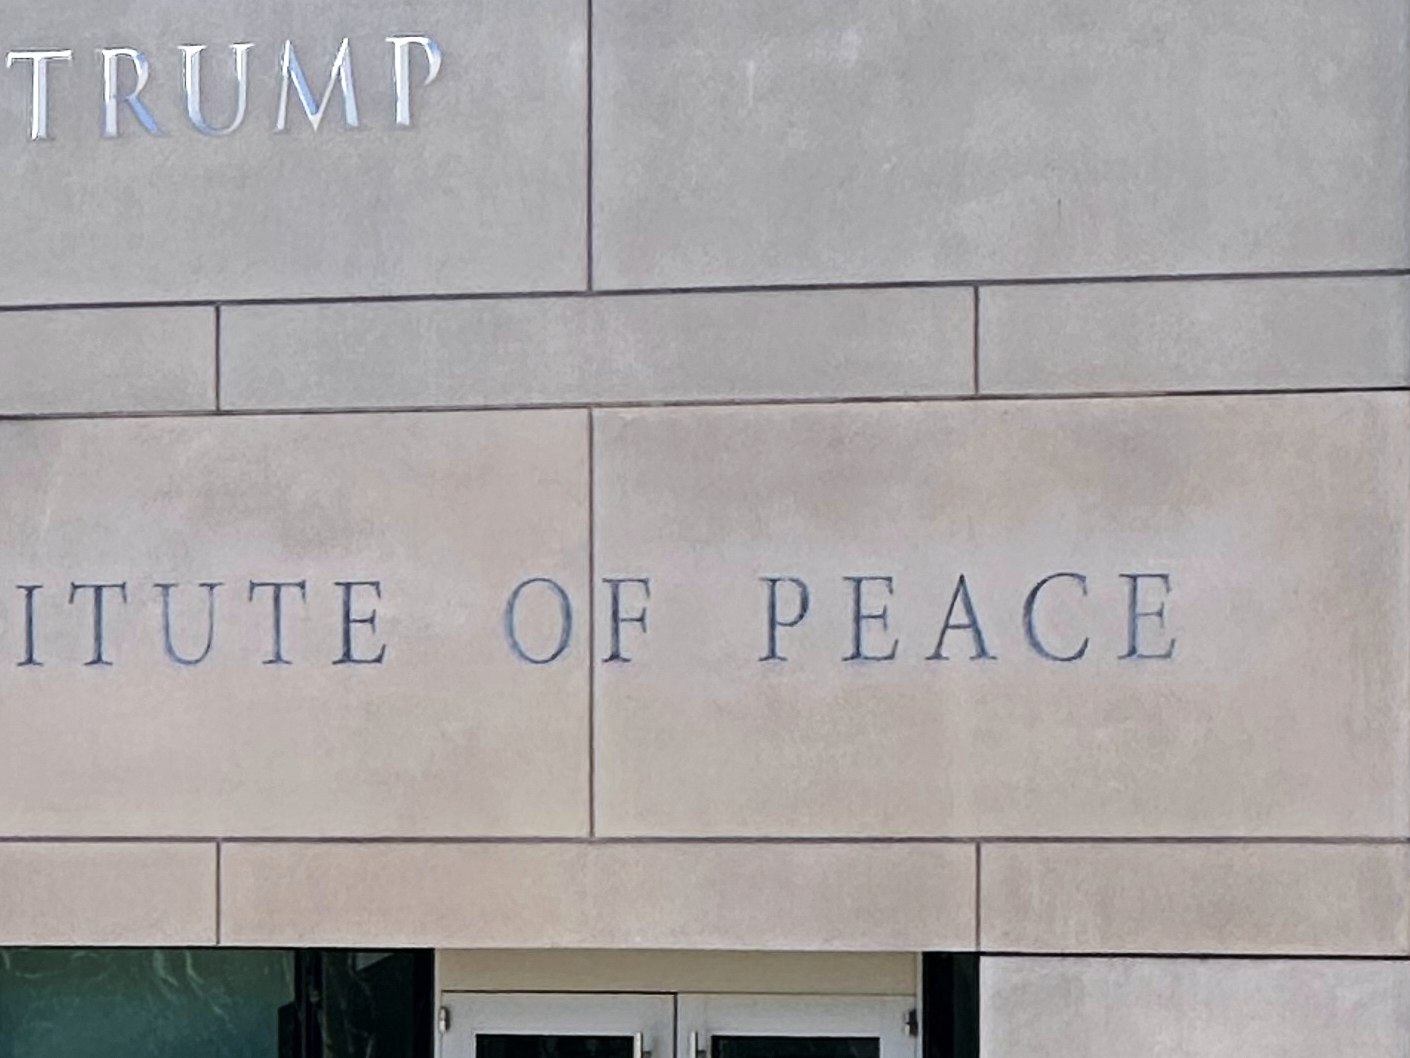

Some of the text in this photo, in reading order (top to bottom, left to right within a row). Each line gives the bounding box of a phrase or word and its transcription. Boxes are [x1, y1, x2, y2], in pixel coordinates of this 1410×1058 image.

[5, 35, 443, 140] TRUMP
[503, 576, 652, 664] OF
[758, 571, 1178, 662] PEACE
